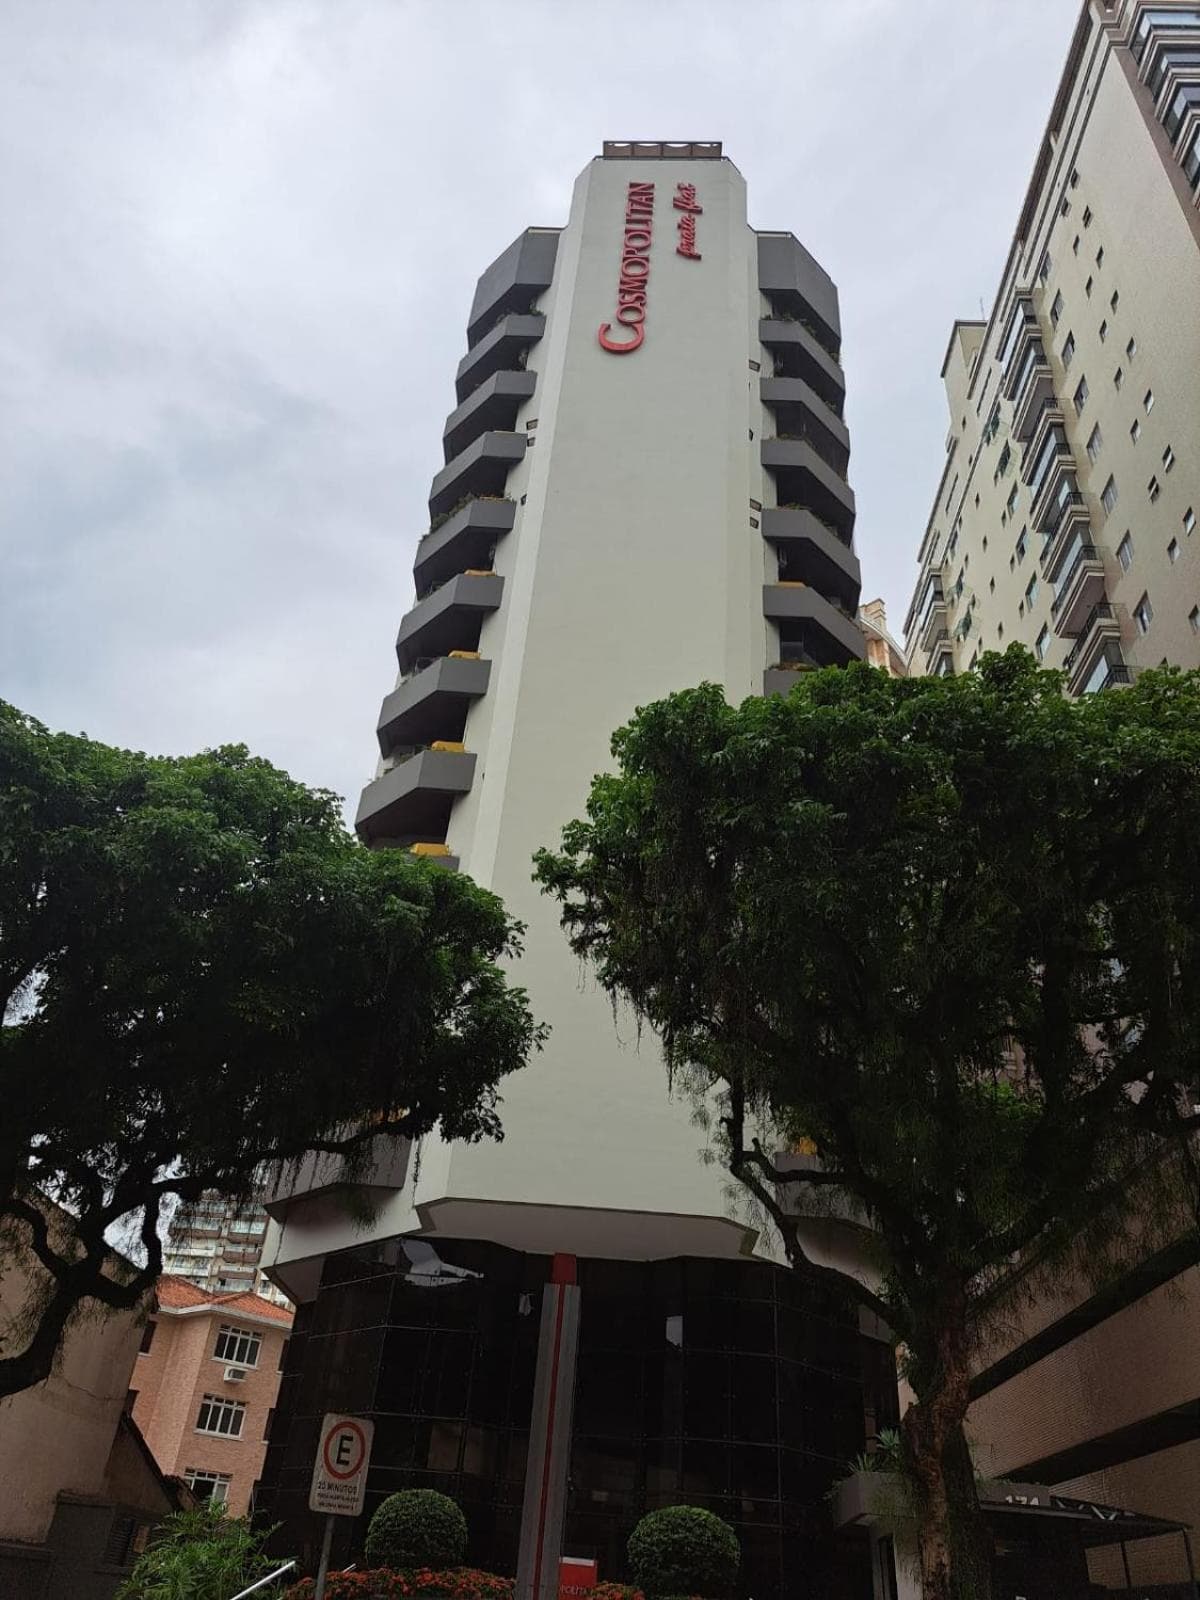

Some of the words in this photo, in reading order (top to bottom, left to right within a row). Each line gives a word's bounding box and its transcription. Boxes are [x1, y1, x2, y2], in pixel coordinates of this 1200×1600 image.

[673, 182, 703, 215] flat
[599, 181, 655, 354] COSMOPOLITAN
[337, 1435, 354, 1465] E
[327, 1482, 358, 1495] MINUTOS
